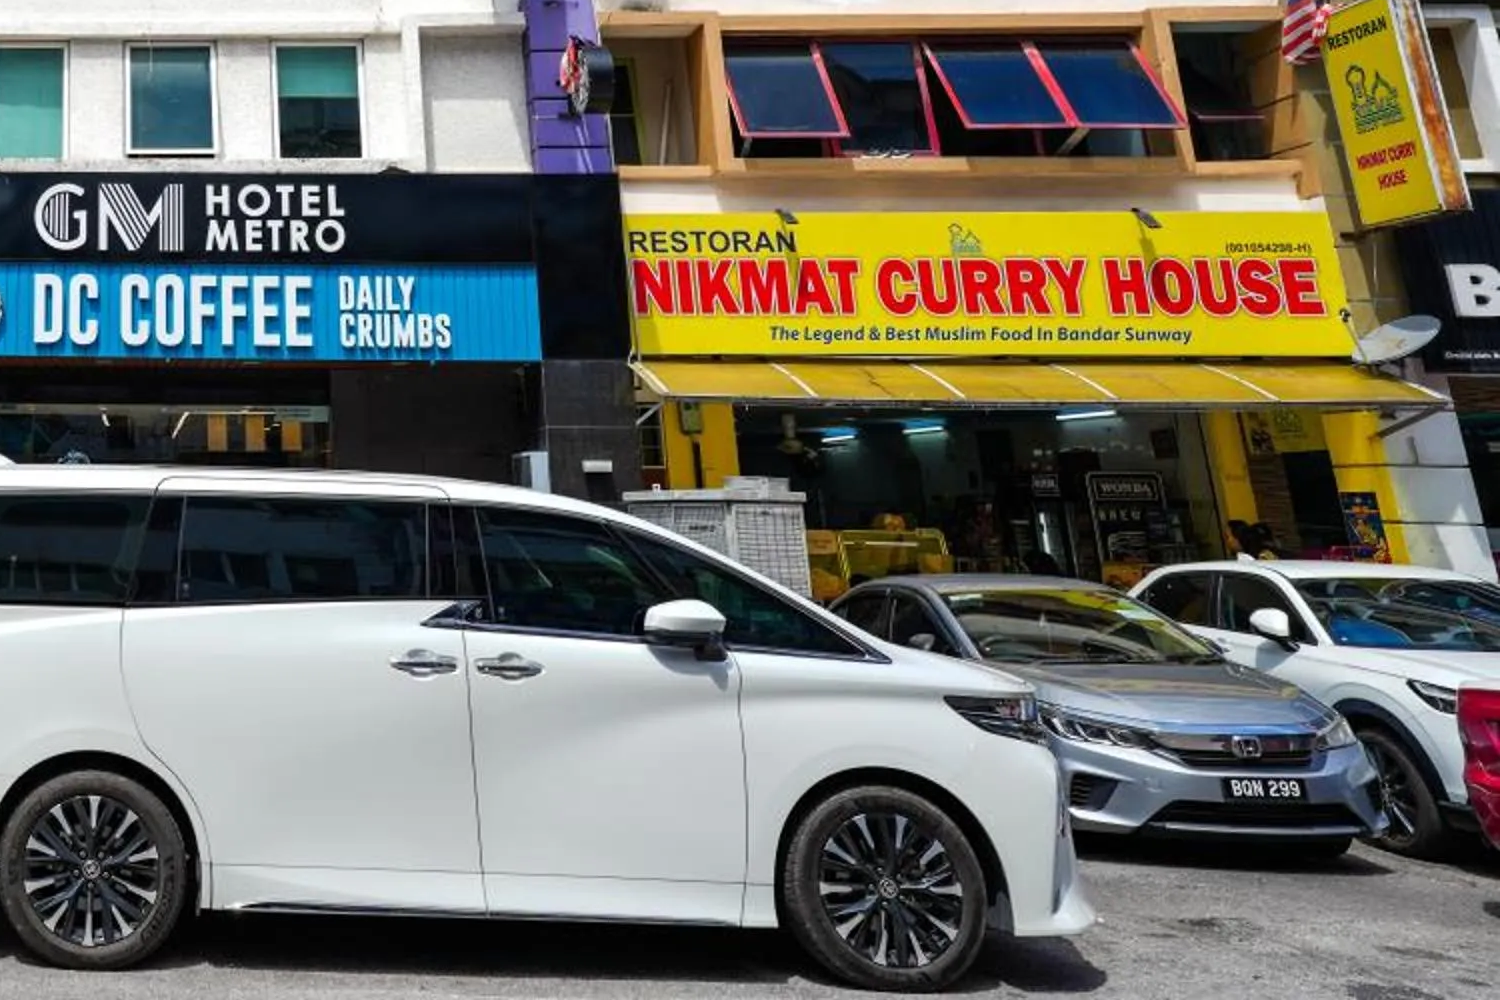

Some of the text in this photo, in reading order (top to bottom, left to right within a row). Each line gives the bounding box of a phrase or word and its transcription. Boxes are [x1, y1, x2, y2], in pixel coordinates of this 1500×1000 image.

[1327, 16, 1387, 50] RESTORAN
[1378, 169, 1408, 190] HOUSE
[33, 183, 345, 251] GM HOTEL
[205, 219, 346, 253] METRO
[629, 231, 797, 253] RESTORAN
[632, 257, 1327, 317] NIKMAT CURRY HOUSE
[33, 273, 416, 347] DC COFFEE DAILY
[340, 313, 452, 349] CRUMBS
[770, 326, 1193, 345] The Legend & Best Muslim Food In Bandar Sunway
[1231, 779, 1301, 797] BQN 299
